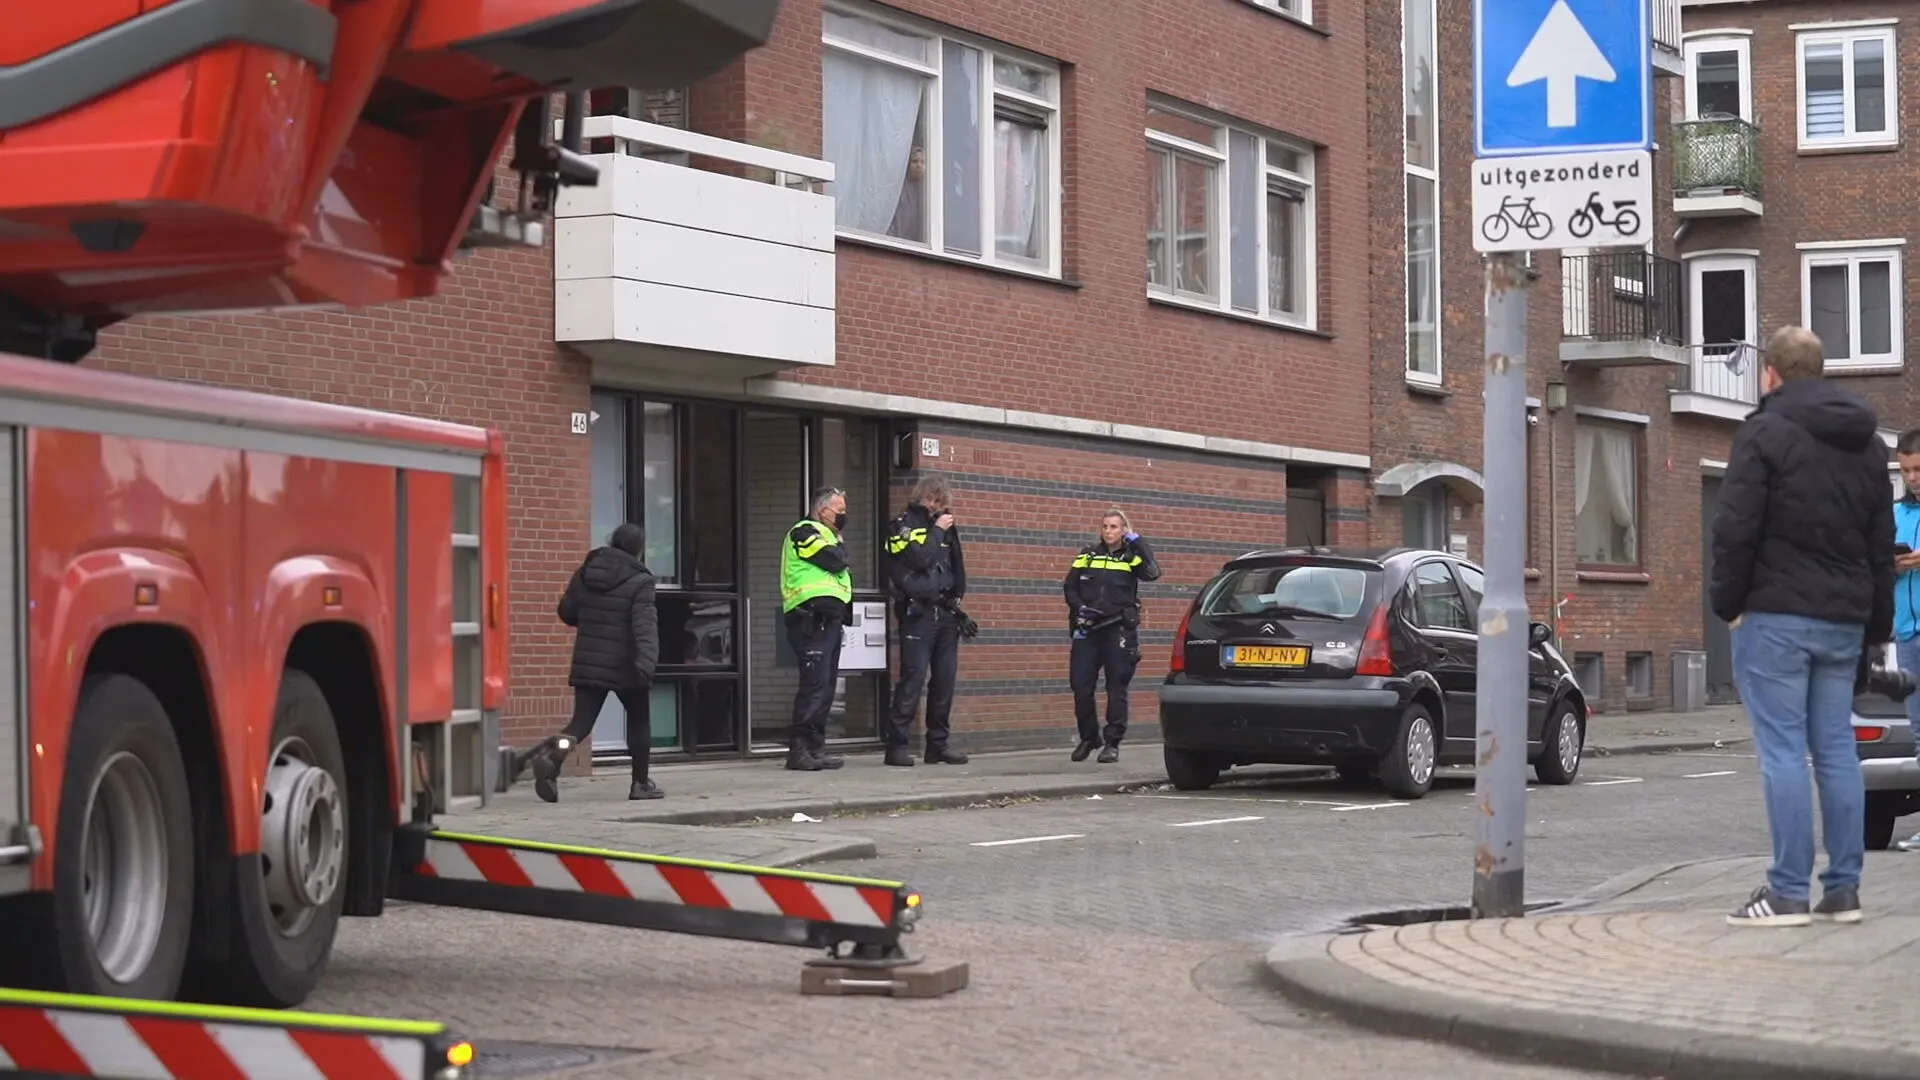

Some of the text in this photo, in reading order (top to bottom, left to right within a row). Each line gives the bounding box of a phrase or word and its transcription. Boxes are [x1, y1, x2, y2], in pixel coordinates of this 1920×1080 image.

[1481, 160, 1639, 189] uitgezonderd
[574, 415, 585, 431] 46
[1239, 648, 1299, 662] 31-NJ-NV
